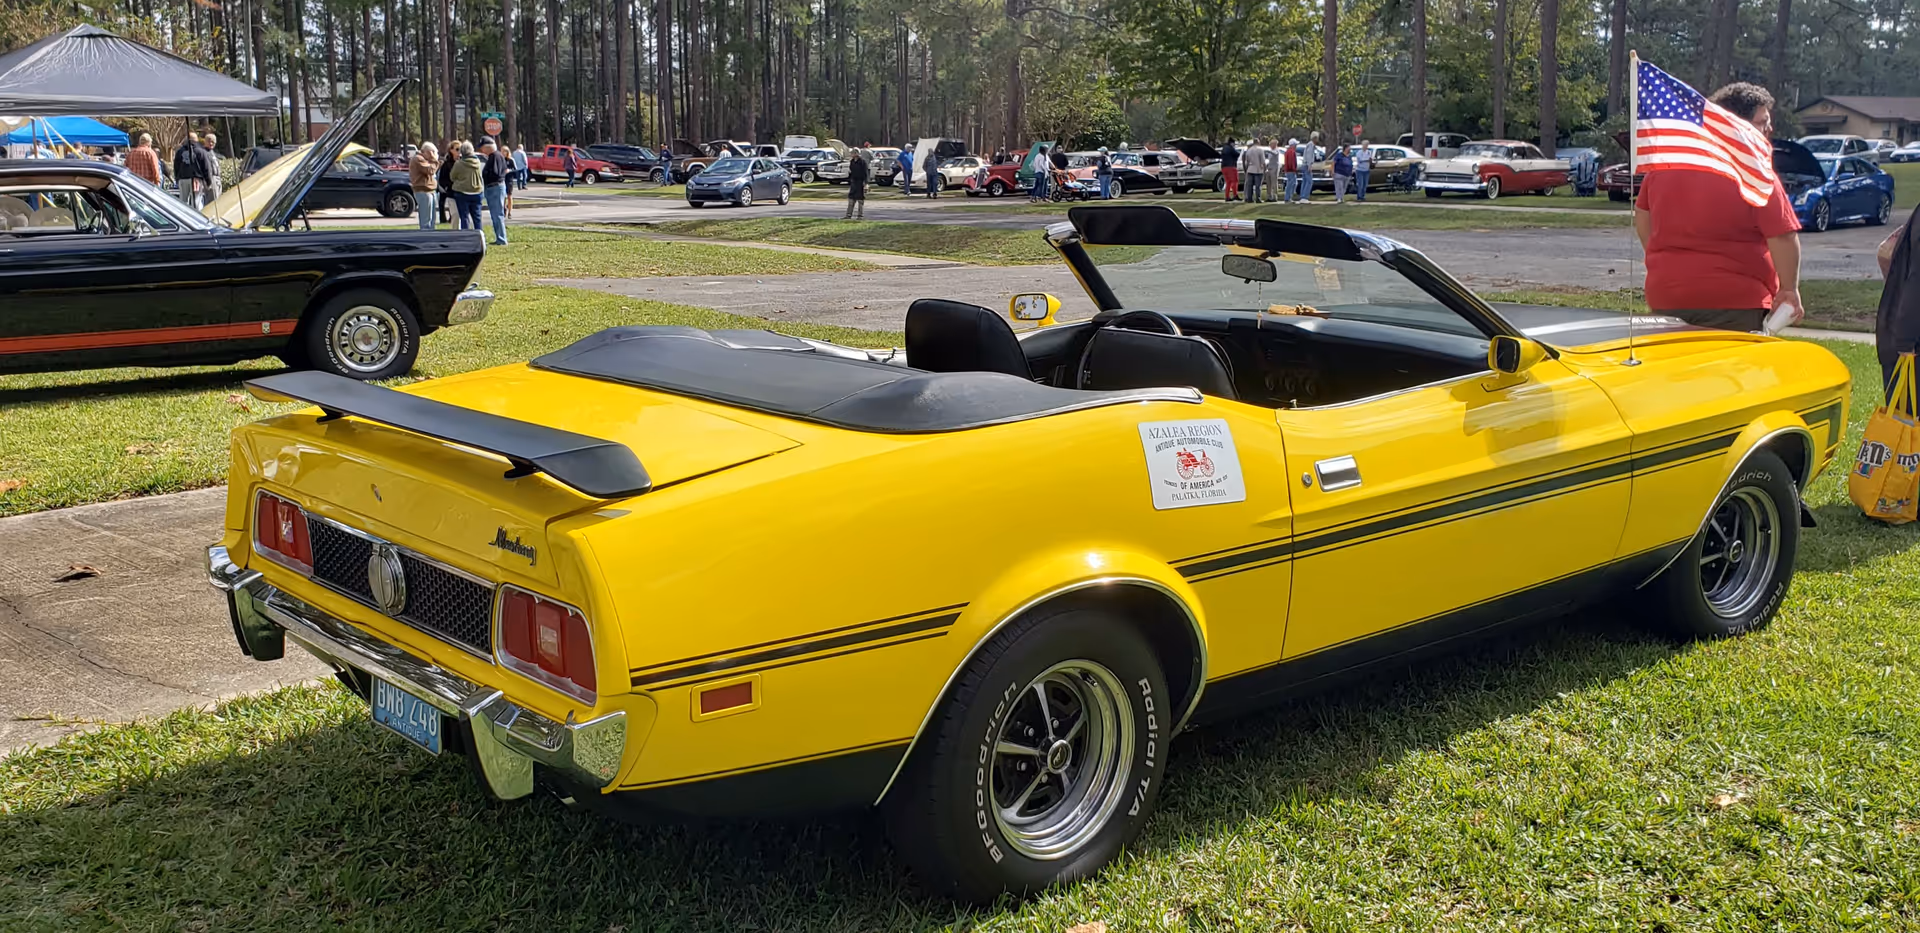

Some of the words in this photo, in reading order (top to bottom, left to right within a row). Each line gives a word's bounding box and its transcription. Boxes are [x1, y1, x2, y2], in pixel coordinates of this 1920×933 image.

[390, 308, 409, 337] Radial
[401, 340, 410, 354] T/A
[1149, 426, 1187, 440] AZALEA
[1187, 424, 1223, 437] REGION
[1155, 439, 1176, 453] ANTIQUE
[1176, 437, 1211, 446] AUTOMOBILE
[1211, 439, 1224, 449] CLUB
[1171, 490, 1201, 502] PALATKA,
[1201, 488, 1227, 500] FLORIDA
[1180, 481, 1188, 490] OF
[1189, 479, 1215, 490] AMERICA
[488, 525, 537, 567] Mustang
[1749, 581, 1784, 633] Radial
[392, 717, 421, 740] ANTIQUE
[1138, 677, 1158, 768] Radial
[976, 681, 1017, 864] BFGoodrich
[1128, 777, 1151, 816] T/A
